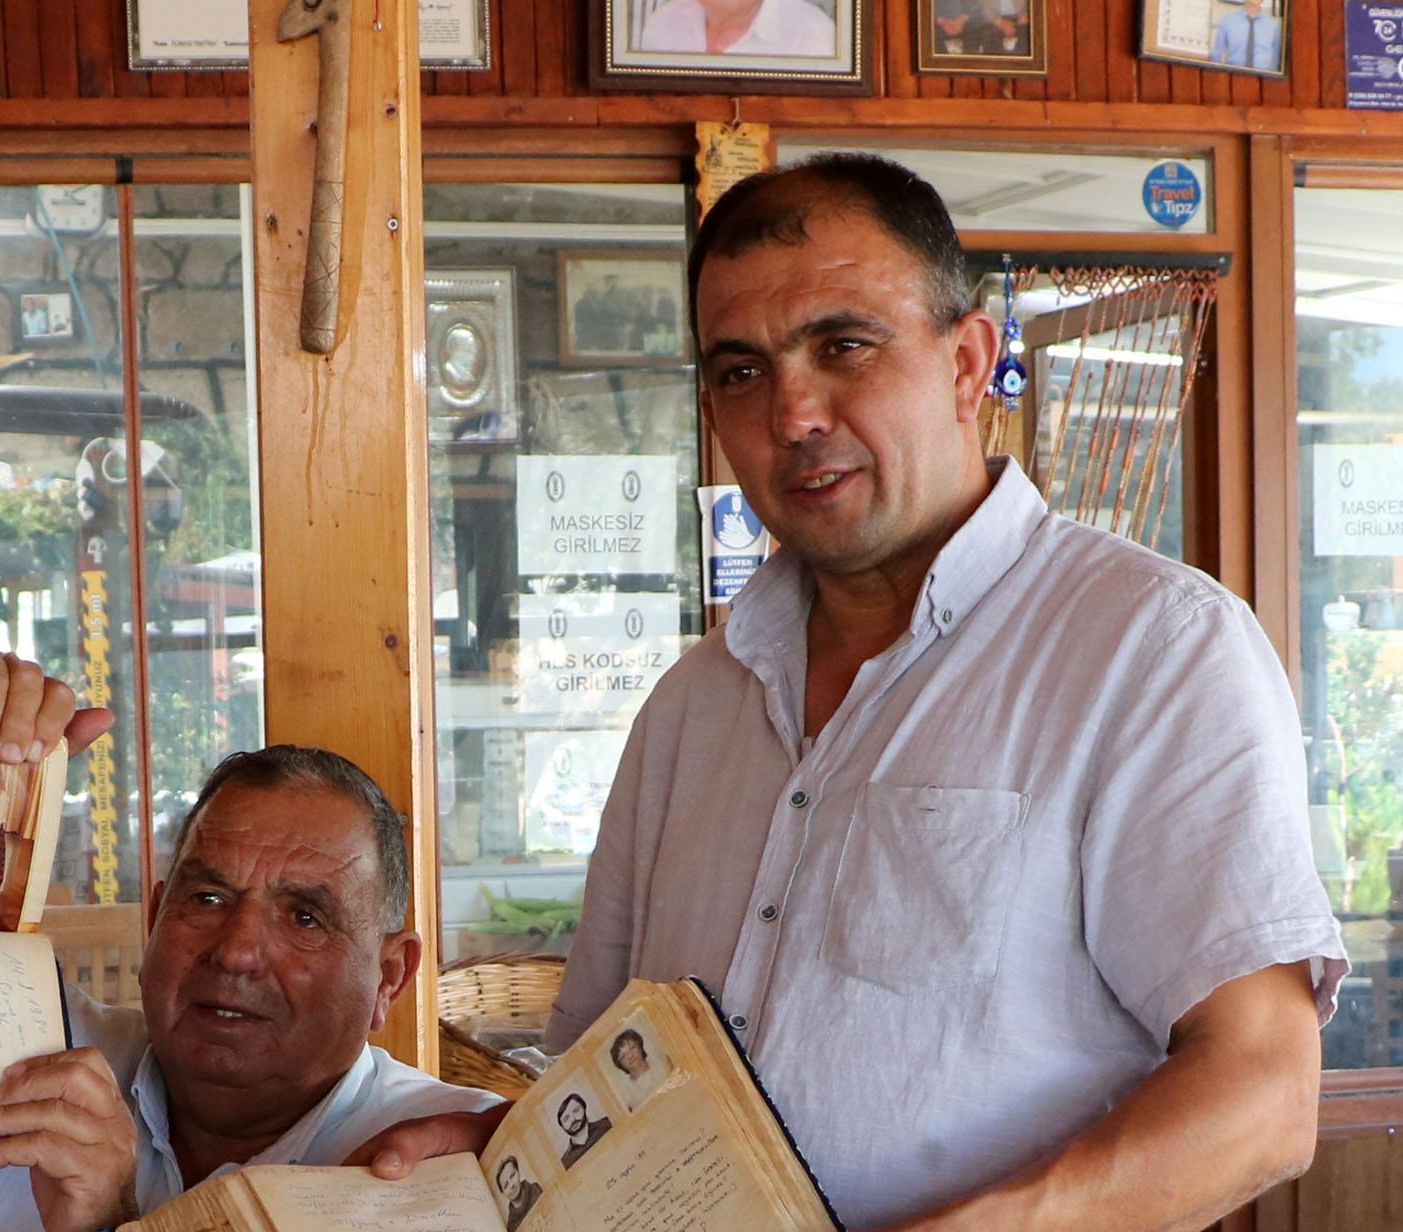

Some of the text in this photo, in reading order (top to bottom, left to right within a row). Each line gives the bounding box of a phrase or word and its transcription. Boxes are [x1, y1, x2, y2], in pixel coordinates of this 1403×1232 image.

[1149, 185, 1194, 200] Travel
[1164, 200, 1194, 217] Tipz
[550, 512, 645, 531] MASKESİZ
[1345, 521, 1403, 536] GİRİLM
[553, 537, 642, 554] GİRİLMEZ
[583, 653, 662, 669] KODSUZ
[555, 675, 645, 692] GİRİLMEZ
[100, 818, 110, 861] SOSYAL
